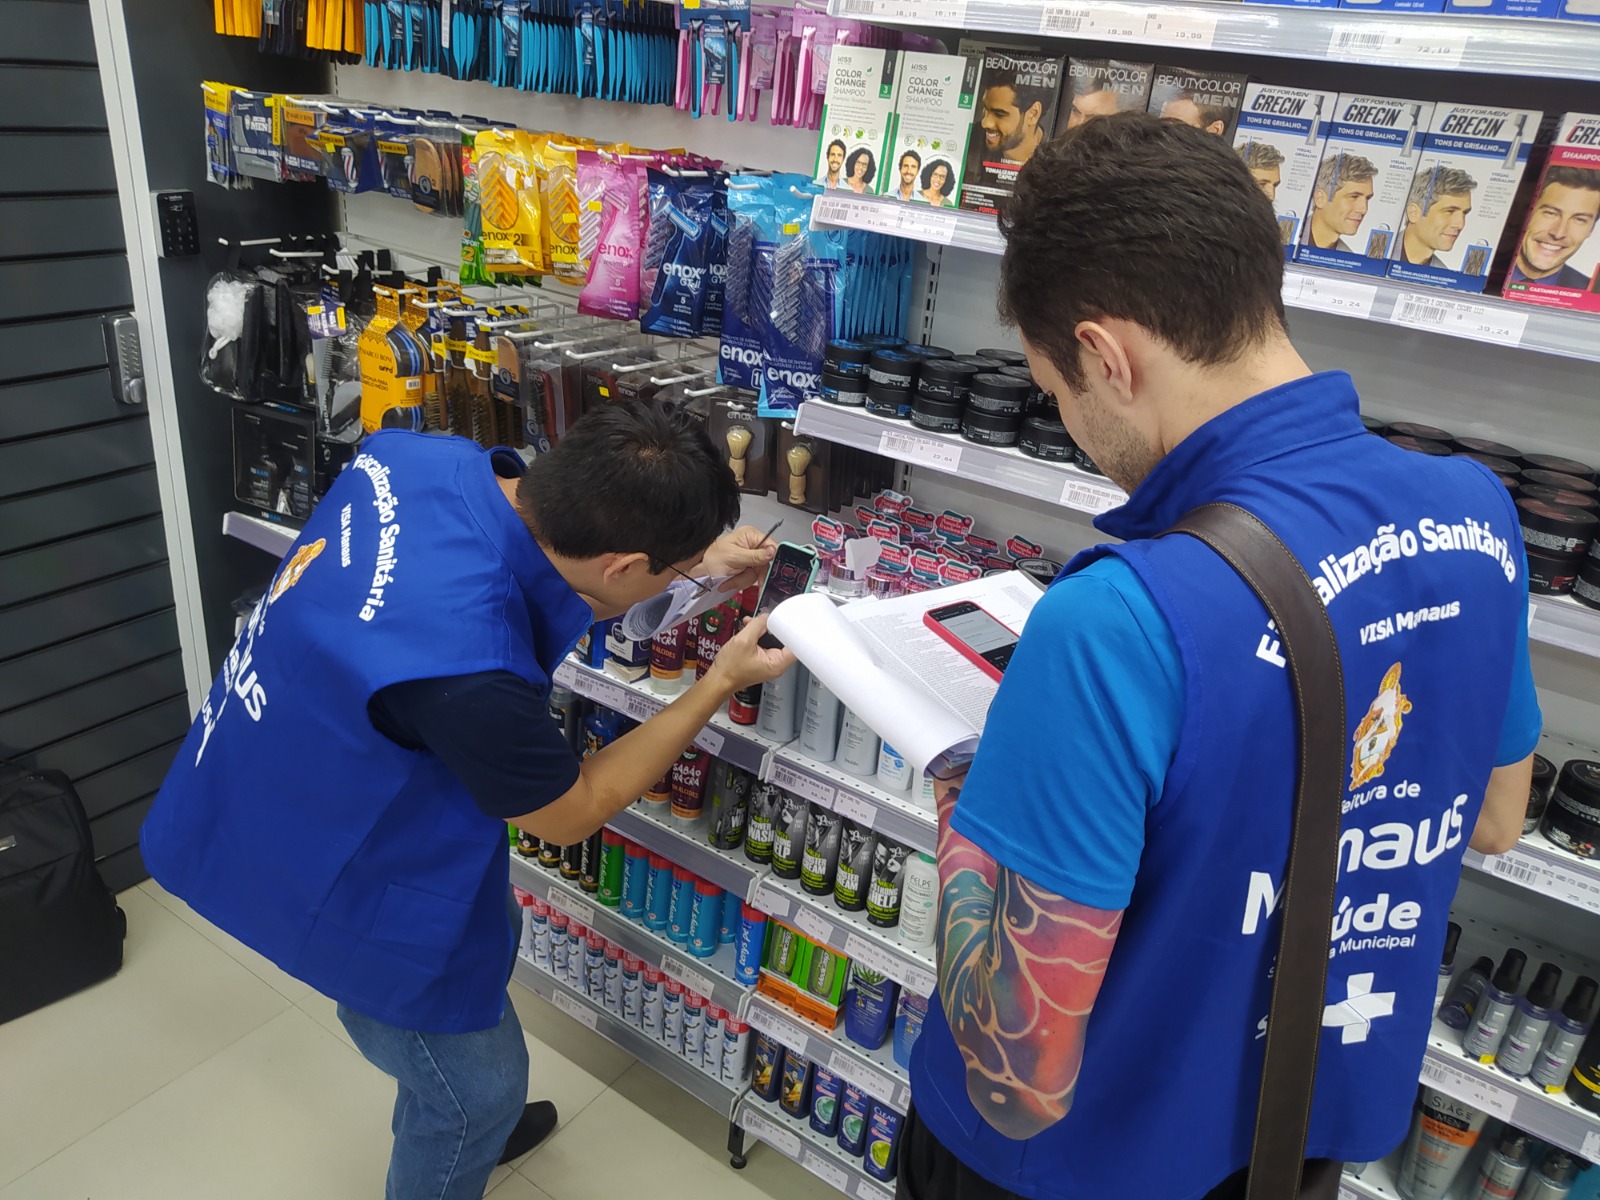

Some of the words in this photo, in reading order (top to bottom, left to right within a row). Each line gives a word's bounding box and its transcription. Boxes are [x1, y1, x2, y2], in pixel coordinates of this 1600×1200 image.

[836, 68, 862, 78] COLOR
[985, 57, 1058, 75] BEAUTYCOLOR
[1069, 64, 1148, 83] BEAUTYCOLOR
[834, 77, 866, 88] CHANGE
[908, 76, 939, 87] COLOR
[1015, 74, 1056, 88] MEN
[1102, 81, 1145, 96] MEN
[1158, 74, 1241, 94] BEAUTYCOLOR
[833, 87, 866, 97] SHAMPOO
[883, 86, 888, 94] 3
[908, 86, 944, 98] CHANGE
[906, 96, 942, 106] SHAMPOO
[963, 96, 969, 104] 3
[1192, 92, 1239, 108] MEN
[1250, 94, 1306, 116] GRECIN
[1246, 116, 1263, 124] TONS
[1263, 118, 1272, 126] DE
[1272, 119, 1302, 129] GRISALHO
[1342, 104, 1402, 126] GRECIN
[1576, 118, 1596, 126] JUST
[1338, 127, 1354, 135] TONS
[1364, 130, 1396, 140] GRISALHO
[1440, 114, 1506, 138] GRECIN
[1565, 125, 1600, 146] GRE
[1434, 138, 1453, 148] TONS
[1453, 140, 1463, 148] DE
[1464, 142, 1498, 152] GRISALHO
[985, 167, 1018, 176] TONALIZANT
[482, 230, 510, 241] enox
[463, 246, 475, 262] 2
[550, 244, 577, 255] enox
[598, 243, 634, 258] enox
[662, 262, 701, 279] enox
[1529, 286, 1558, 296] CASTANHO
[1558, 290, 1582, 298] ESCURO
[680, 296, 686, 304] 5
[720, 344, 763, 367] enox
[767, 366, 816, 389] enox
[618, 387, 636, 397] enox
[727, 411, 753, 422] enox
[352, 454, 398, 524] Fiscalização
[340, 503, 352, 530] VISA
[340, 527, 352, 568] Manaus
[1418, 516, 1516, 584] Sanitária
[358, 524, 400, 622] Sanitária
[1360, 616, 1394, 646] VISA
[1396, 600, 1460, 632] Manaus
[656, 646, 676, 659] ALCIDES
[680, 785, 699, 798] ALCIDES
[1342, 784, 1388, 814] eitura
[1393, 780, 1421, 798] de
[748, 824, 775, 843] WASH
[774, 842, 791, 859] ELP
[876, 880, 895, 889] MEN
[910, 874, 932, 888] FELPS
[872, 891, 898, 908] HELP
[1331, 893, 1422, 942] úde
[1339, 934, 1416, 954] Municipal
[874, 1106, 897, 1124] CLEAR
[1436, 1113, 1460, 1128] MEN
